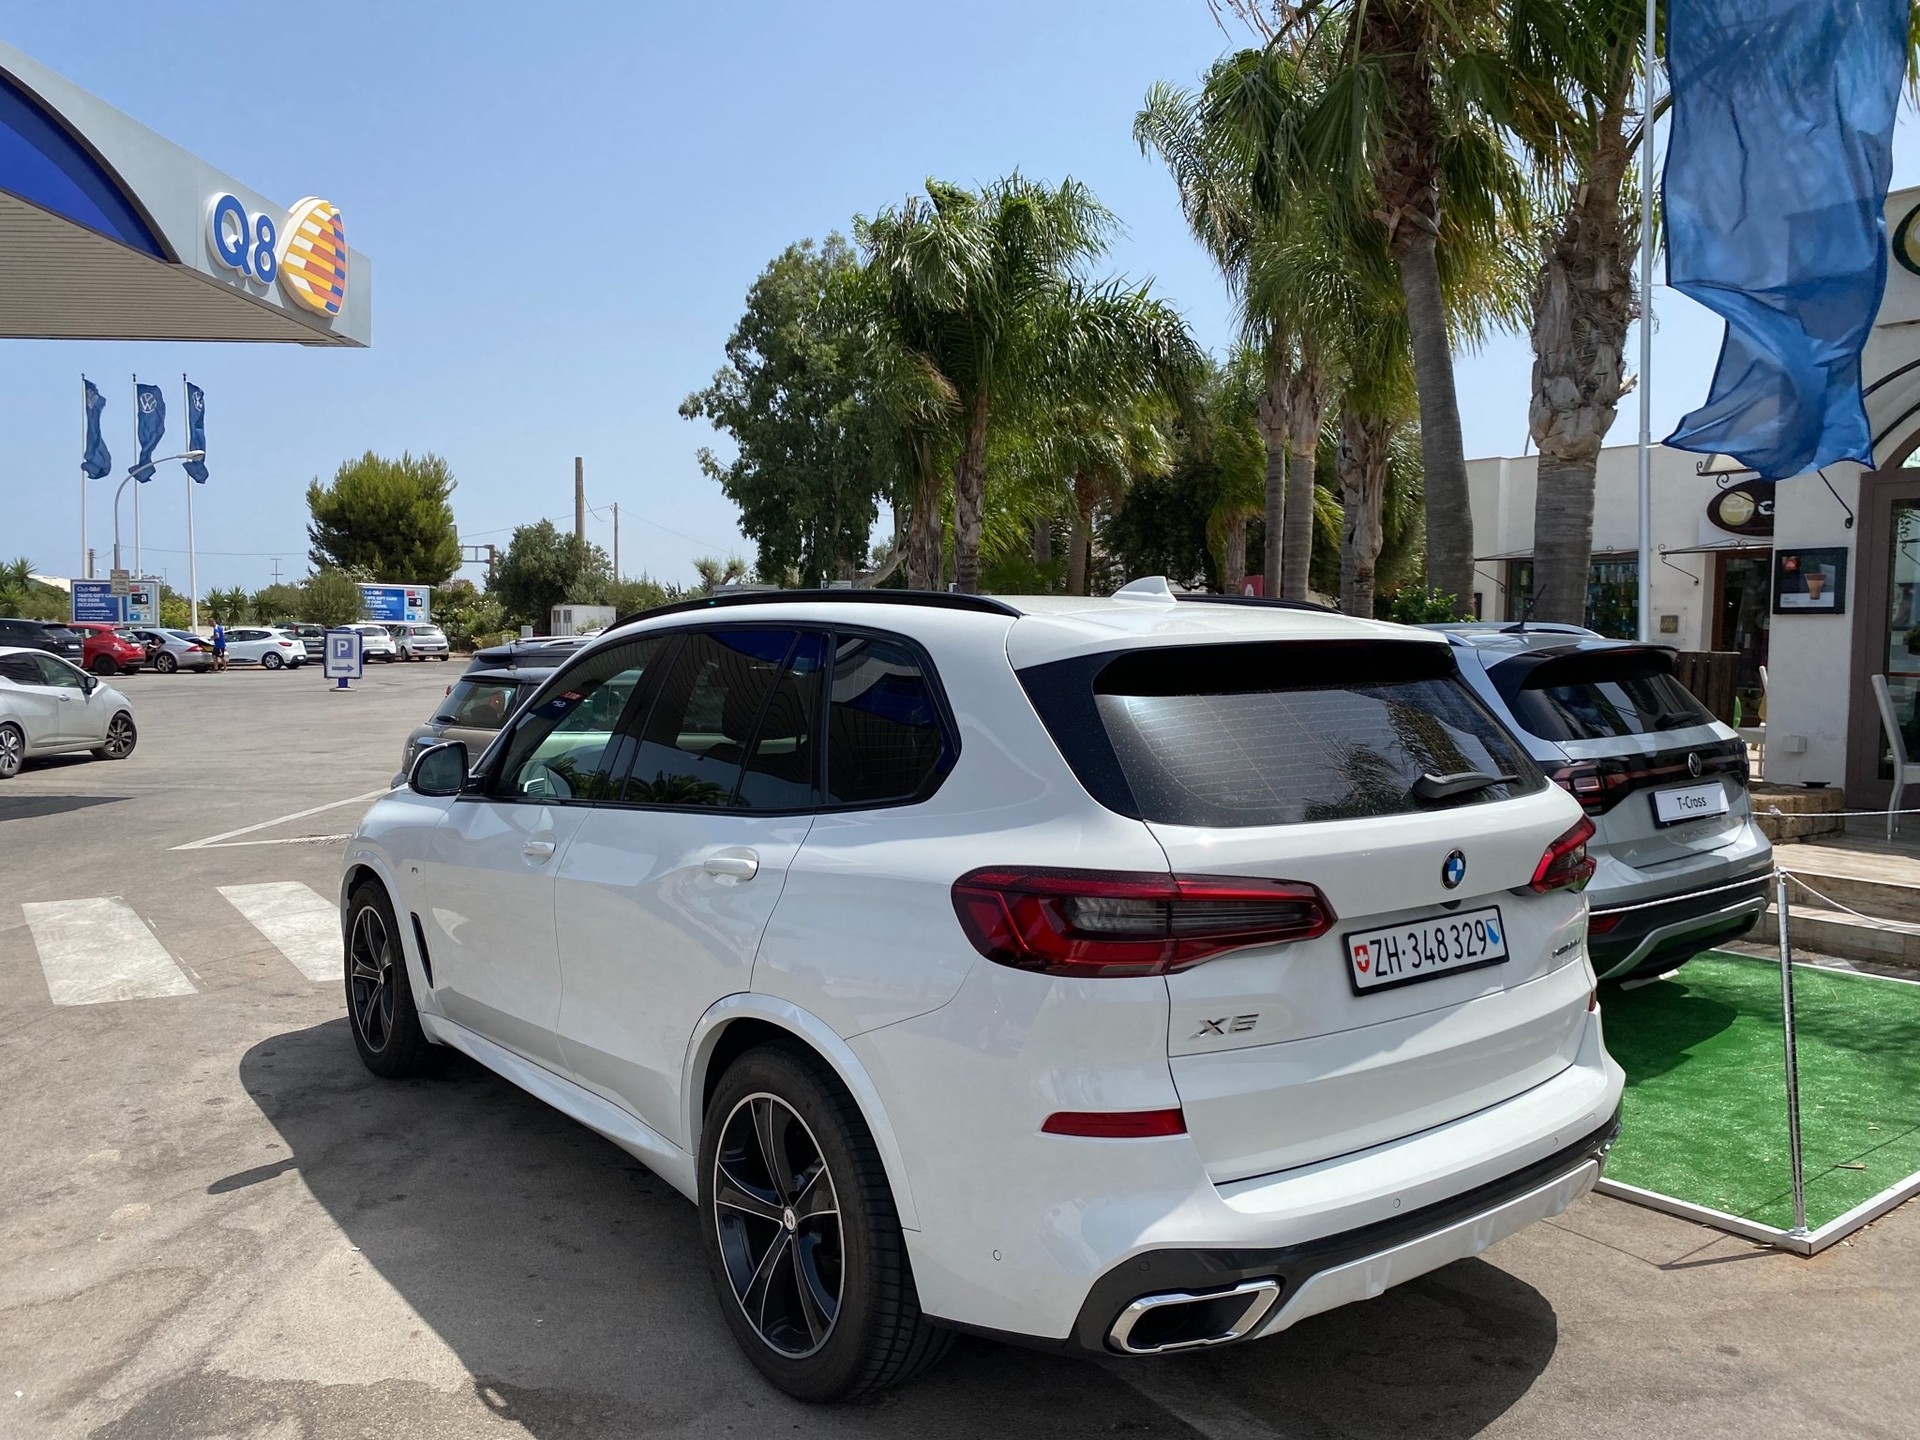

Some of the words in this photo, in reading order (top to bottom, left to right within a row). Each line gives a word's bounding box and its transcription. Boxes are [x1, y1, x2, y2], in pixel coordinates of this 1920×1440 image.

[207, 192, 278, 285] Q8
[337, 640, 349, 656] P
[1676, 796, 1707, 810] T-Cross
[1189, 1014, 1259, 1039] X5
